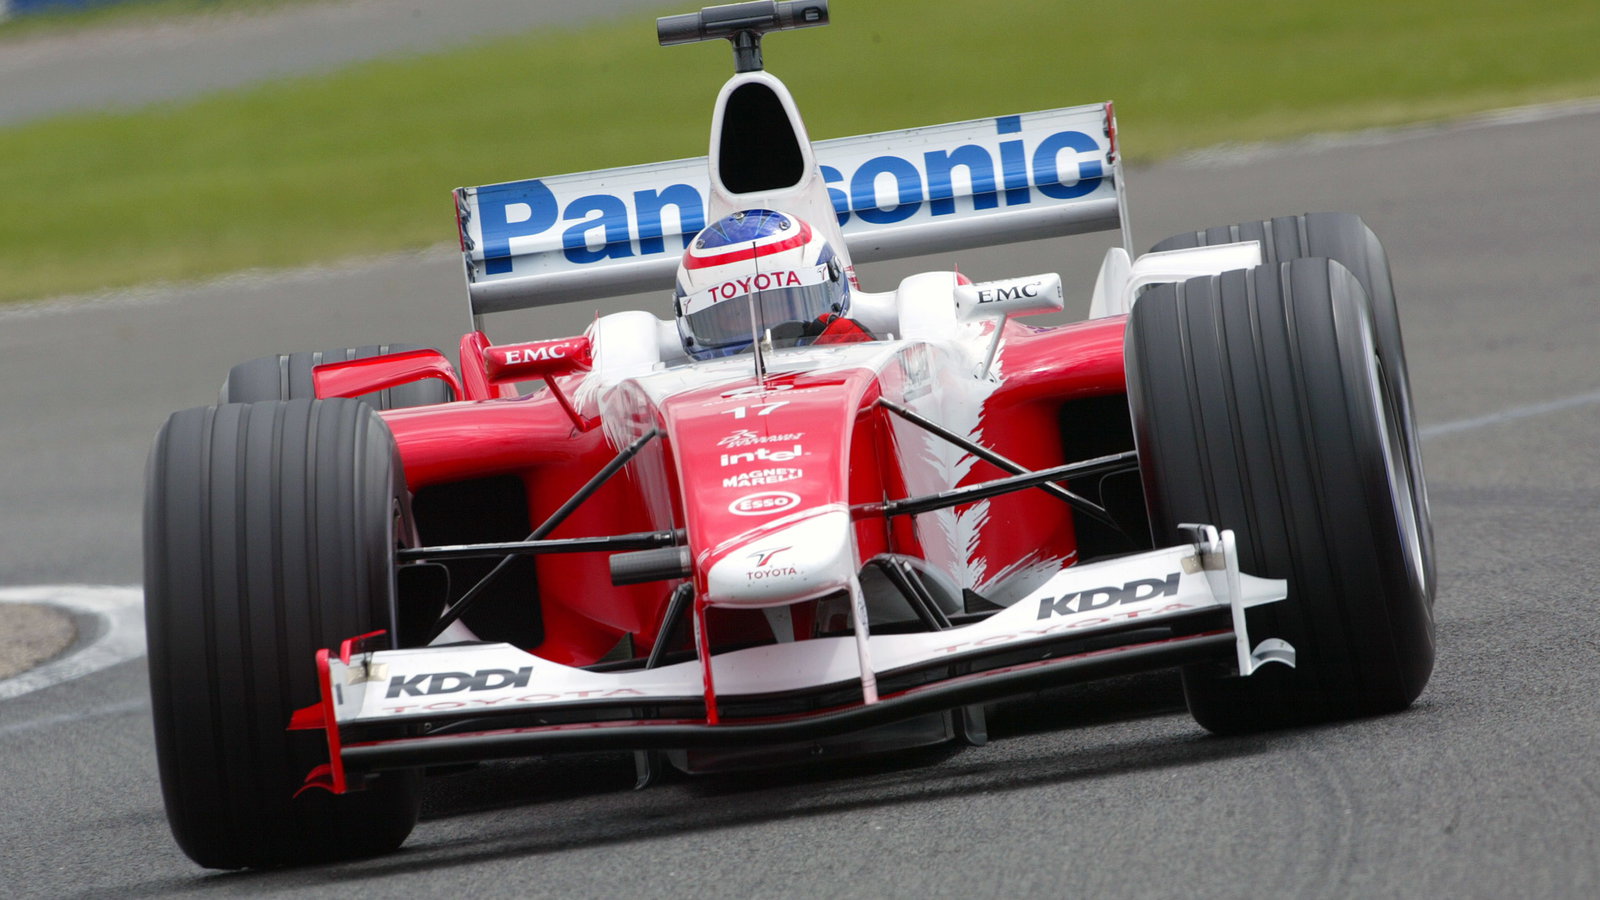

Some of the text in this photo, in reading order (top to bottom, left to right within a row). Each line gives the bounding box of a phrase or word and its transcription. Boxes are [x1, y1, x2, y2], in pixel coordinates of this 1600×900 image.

[708, 270, 802, 303] TOYOTA
[721, 401, 791, 419] 17
[720, 444, 803, 467] intel
[723, 467, 803, 483] MAGNETI
[746, 567, 797, 580] TOYOTA
[1037, 572, 1181, 620] KDDI
[933, 603, 1196, 652] TOYOTA
[385, 666, 534, 699] KDDI
[382, 688, 647, 713] TOYOTA
